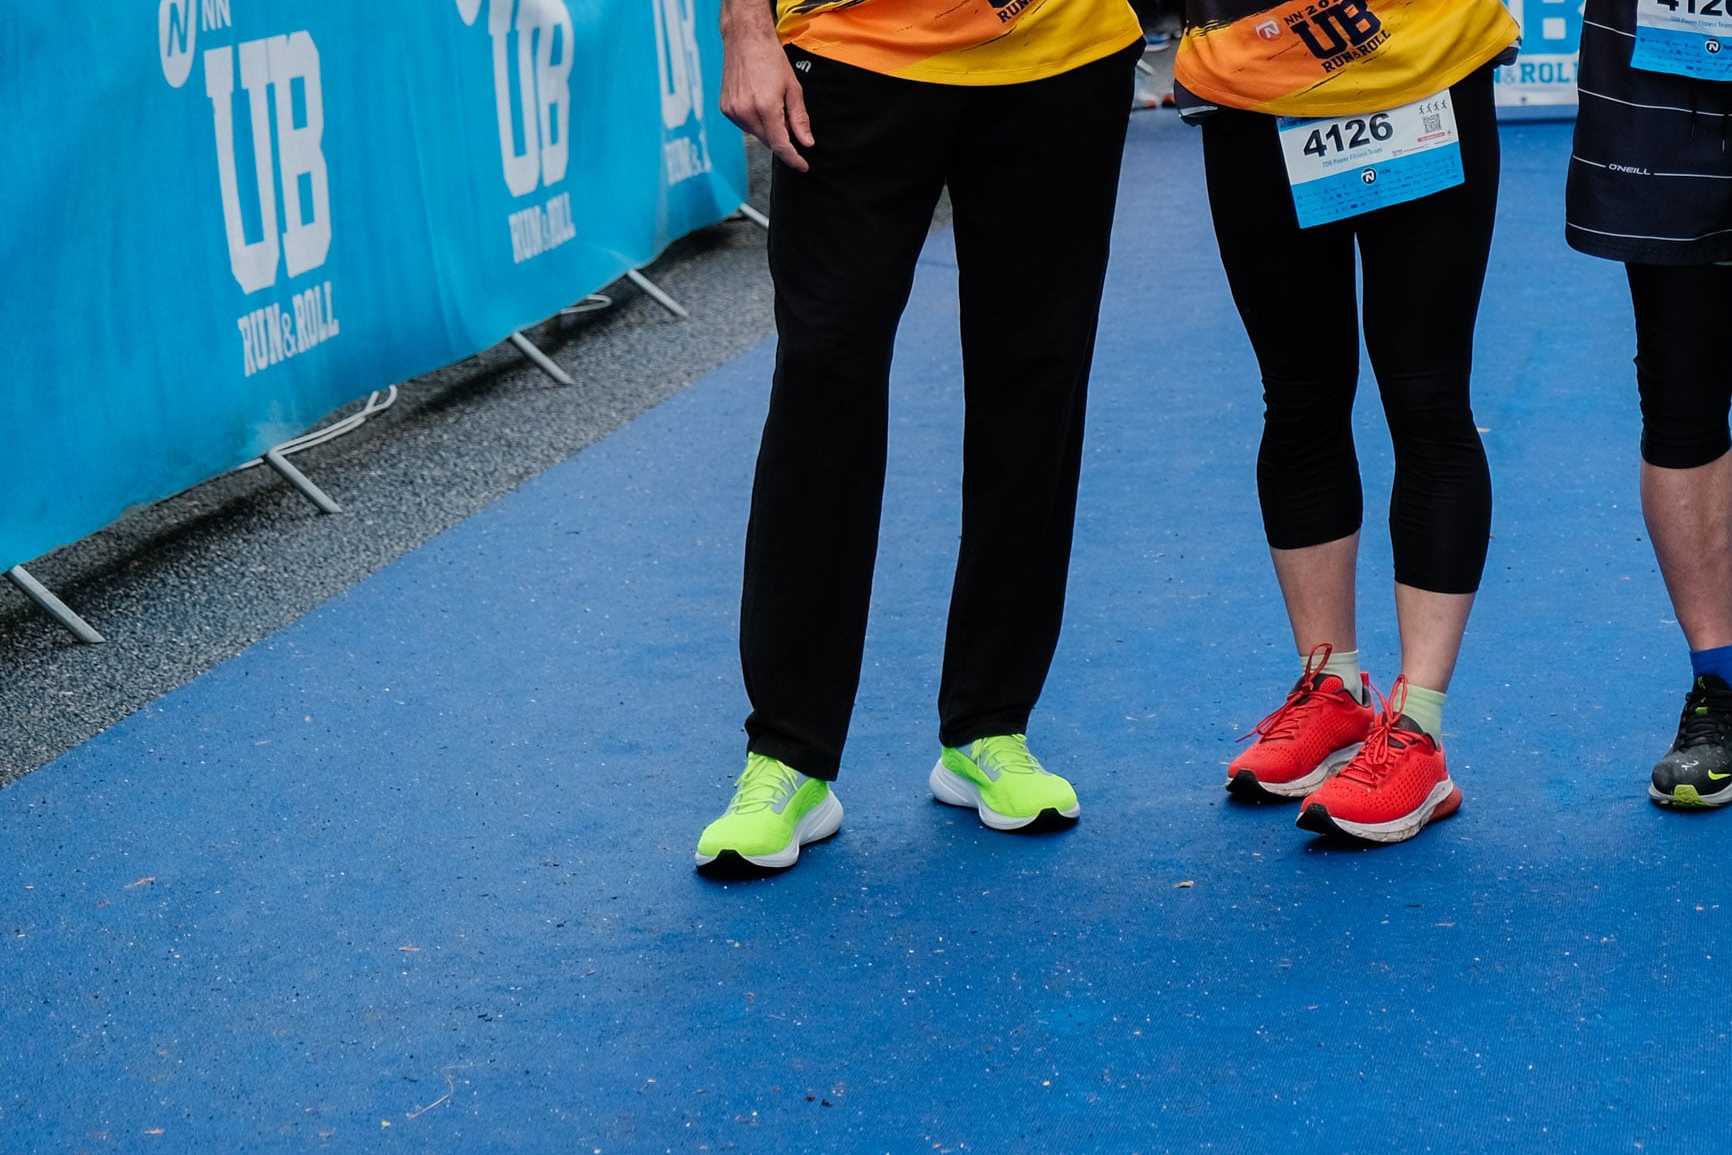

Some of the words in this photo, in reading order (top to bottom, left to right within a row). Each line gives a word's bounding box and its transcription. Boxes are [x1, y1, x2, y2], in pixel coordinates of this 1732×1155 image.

[1284, 11, 1303, 26] NN
[1321, 29, 1392, 73] RUN&ROLL
[1303, 113, 1394, 158] 4126
[203, 30, 332, 295] UB
[237, 281, 339, 377] RUN&ROLL
